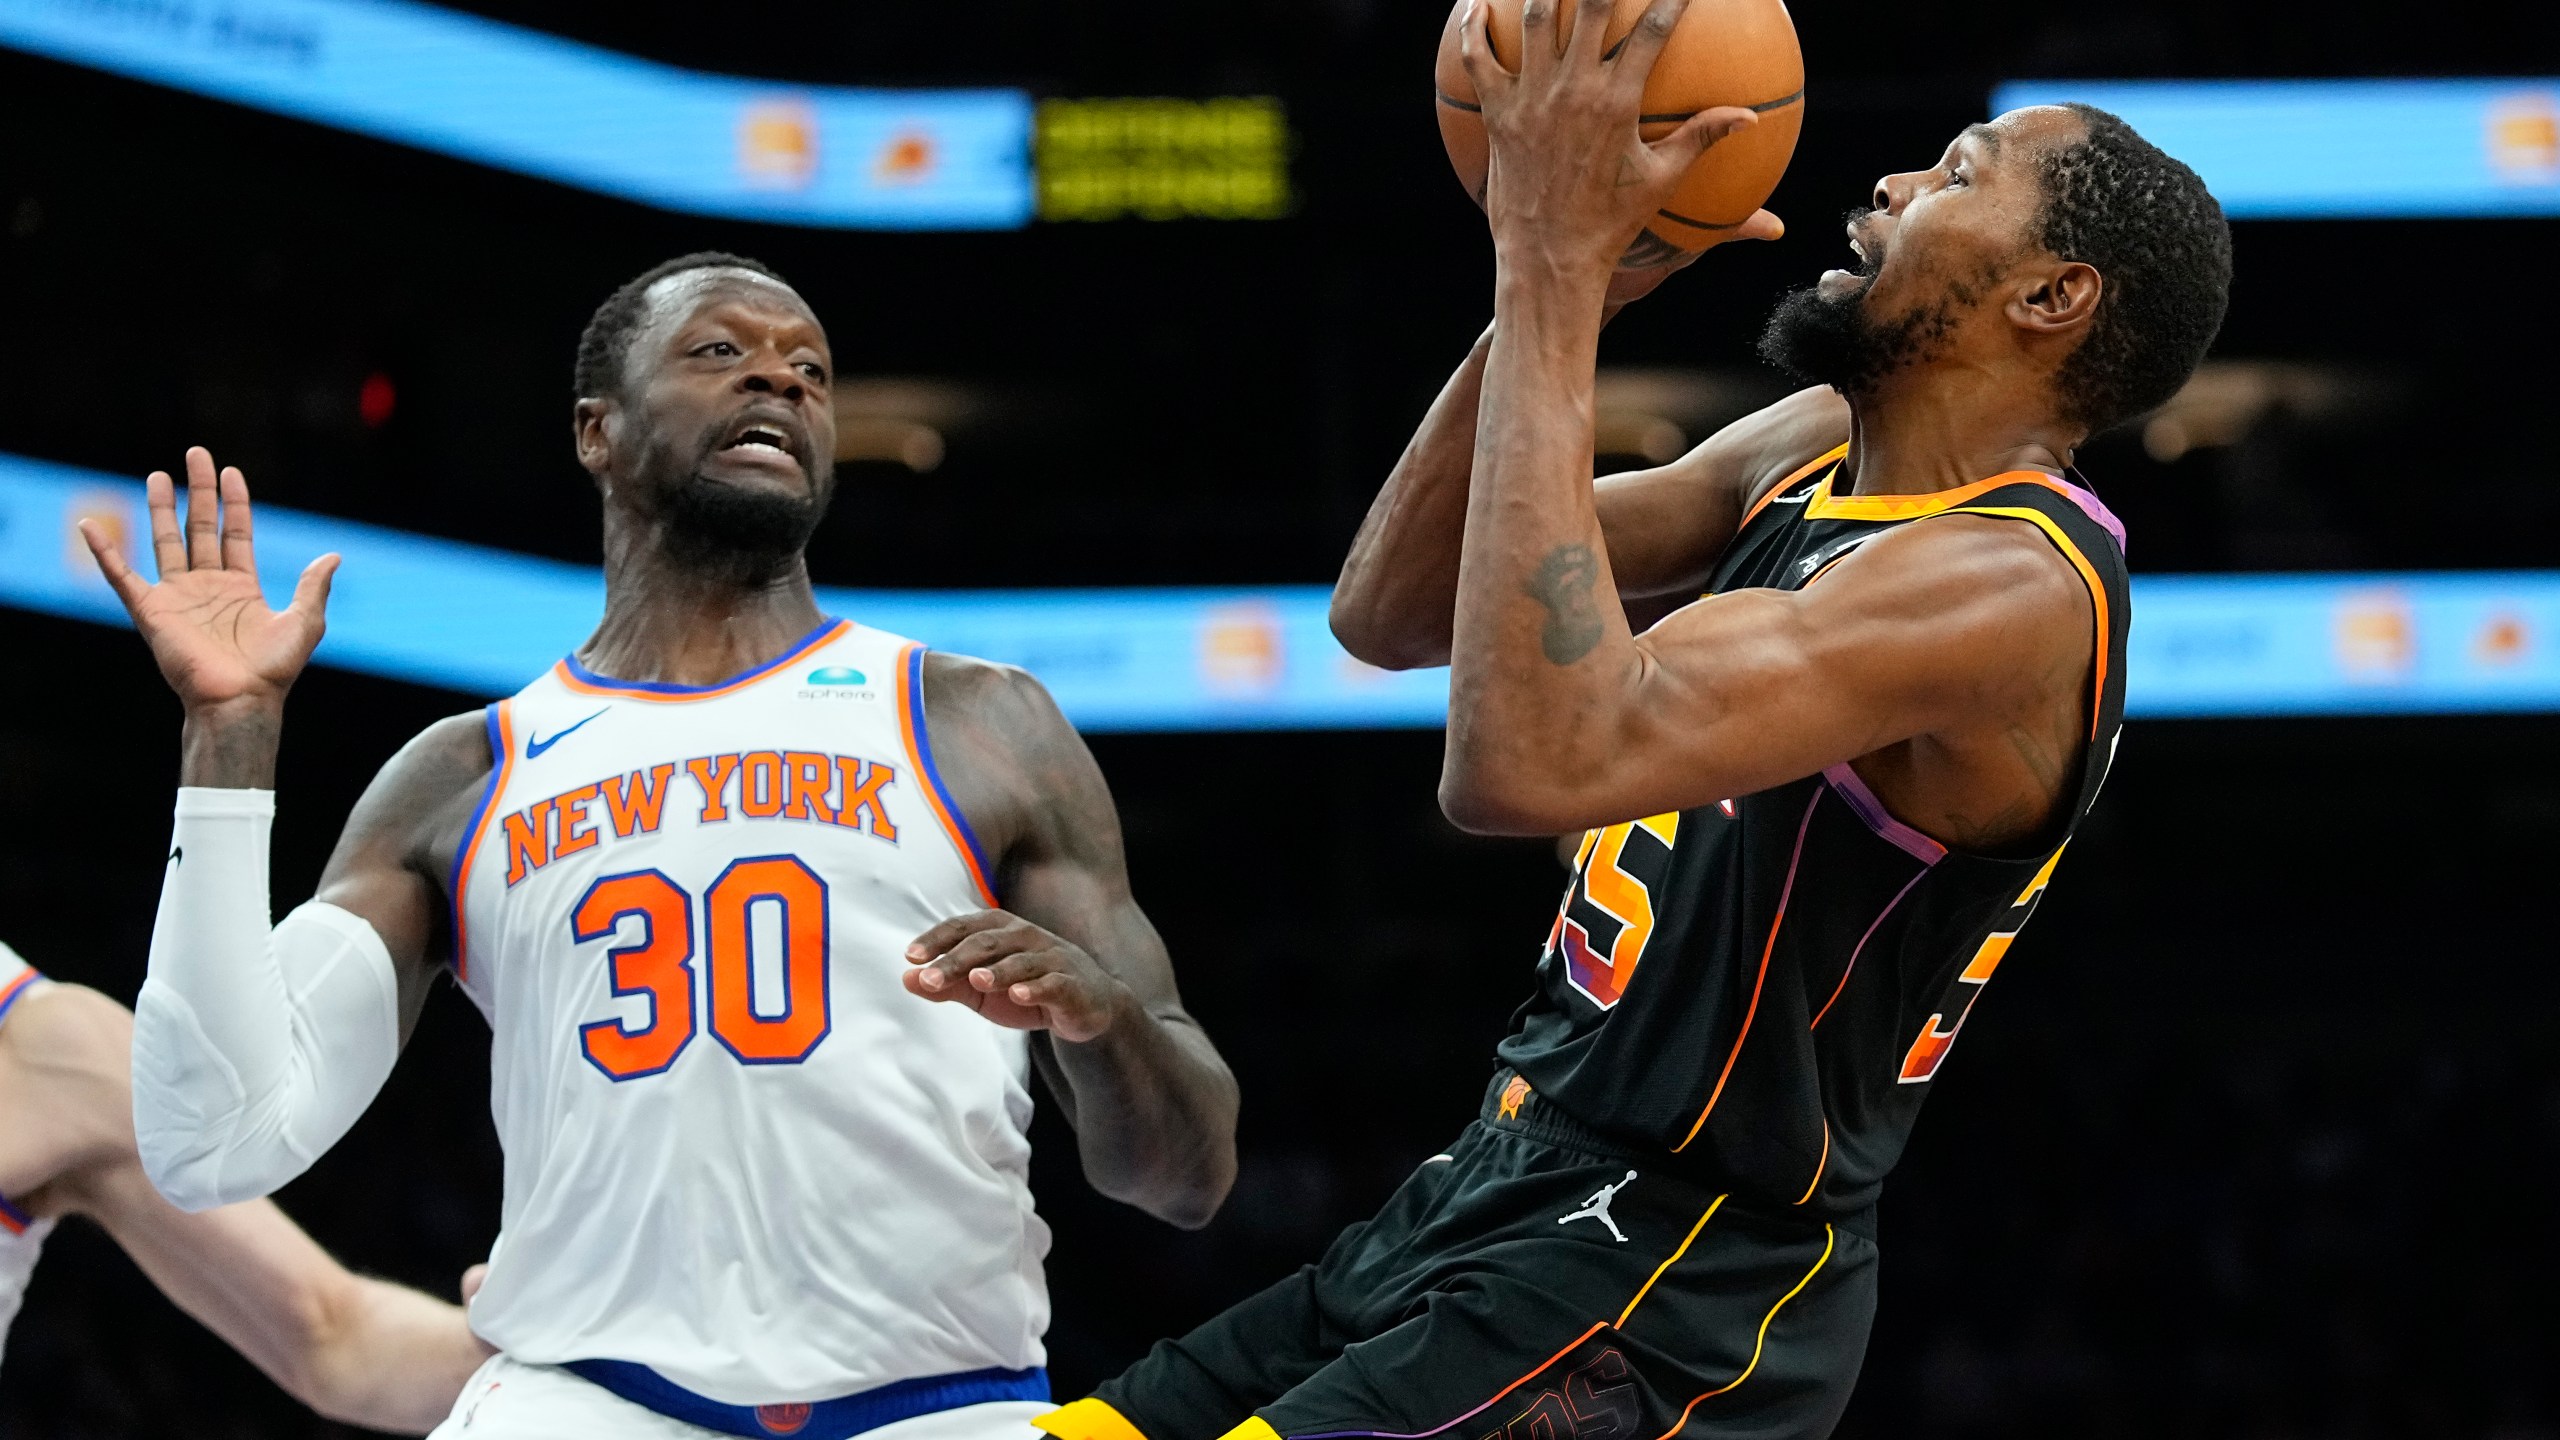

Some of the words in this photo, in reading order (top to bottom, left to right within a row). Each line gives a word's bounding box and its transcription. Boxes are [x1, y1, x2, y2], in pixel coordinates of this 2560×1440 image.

[797, 688, 876, 701] sphere
[502, 763, 675, 888] NEW
[686, 750, 898, 845] YORK
[571, 853, 832, 1083] 30
[1544, 810, 1680, 1011] 5
